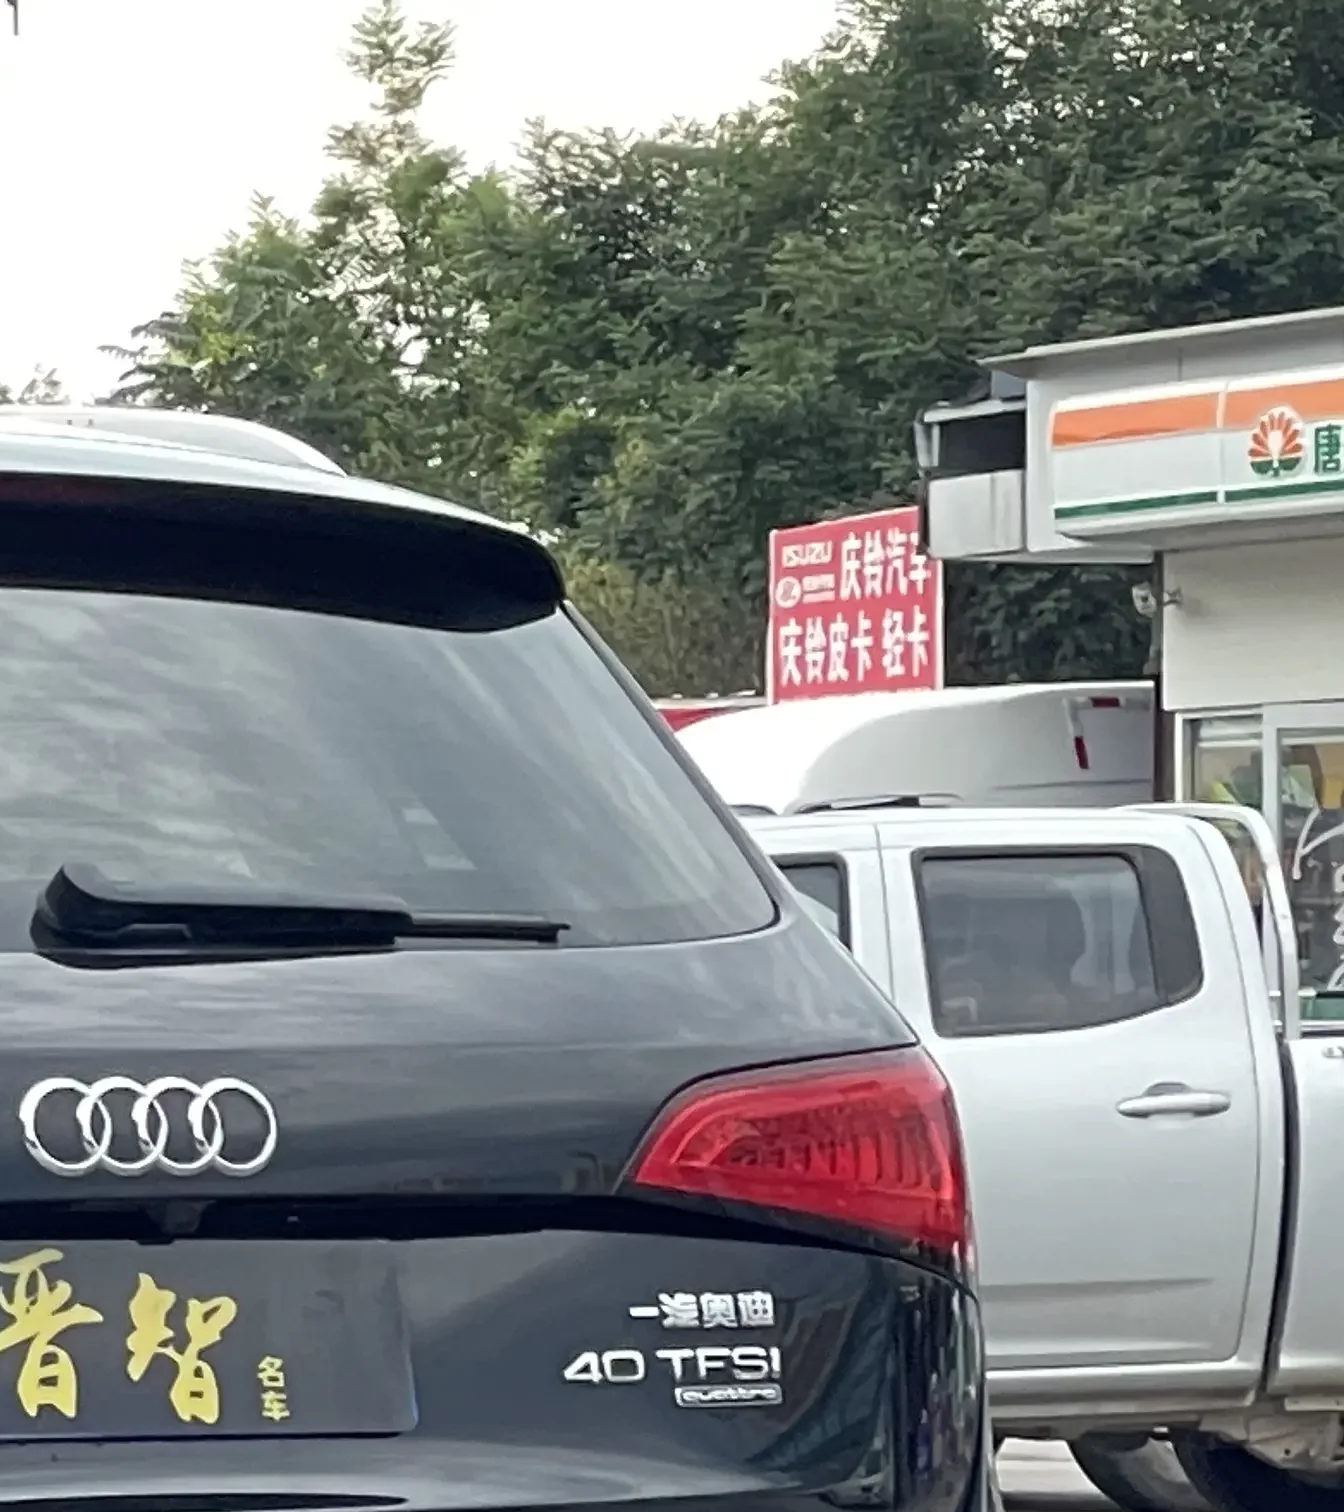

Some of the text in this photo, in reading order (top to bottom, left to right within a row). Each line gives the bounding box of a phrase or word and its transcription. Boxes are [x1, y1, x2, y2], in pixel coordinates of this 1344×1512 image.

[840, 528, 931, 600] 庆铃汽车
[778, 611, 874, 687] 庆铃皮卡
[629, 1291, 774, 1327] 一汽奥迪
[257, 1356, 290, 1421] 名车
[564, 1347, 781, 1382] 40 TFSI
